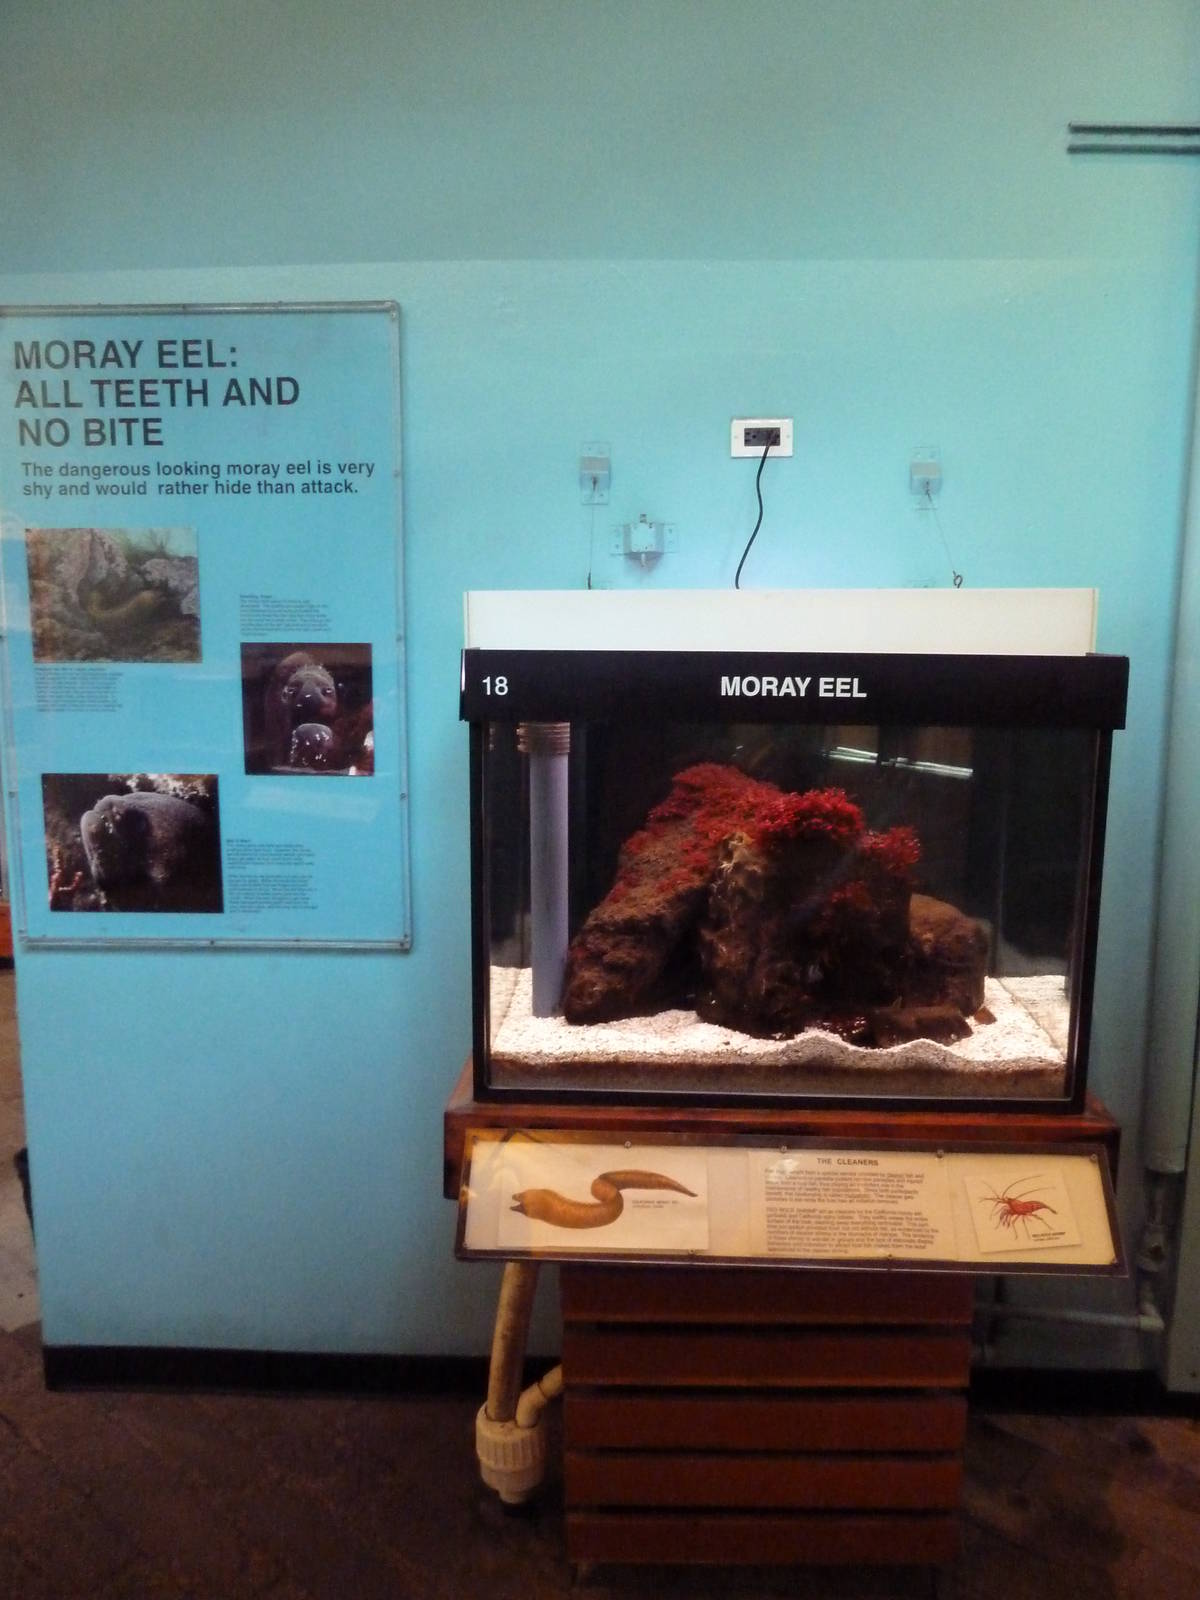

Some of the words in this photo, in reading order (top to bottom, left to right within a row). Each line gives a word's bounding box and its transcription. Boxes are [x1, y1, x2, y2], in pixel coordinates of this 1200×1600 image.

[14, 339, 144, 369] MORAY
[157, 339, 238, 368] EEL:
[14, 379, 83, 409] ALL
[90, 378, 209, 408] TEETH
[222, 376, 300, 407] AND
[18, 418, 70, 447] NO
[84, 417, 164, 446] BITE
[21, 462, 53, 477] The
[59, 462, 151, 480] dangerous
[156, 461, 221, 479] looking
[226, 463, 280, 478] moray
[286, 460, 312, 475] eel
[317, 460, 332, 475] is
[337, 462, 375, 478] very
[23, 482, 52, 499] shy
[58, 482, 90, 496] and
[95, 481, 148, 496] would
[158, 480, 209, 495] rather
[215, 480, 251, 494] hide
[257, 480, 295, 494] than
[300, 479, 359, 494] attack.
[482, 676, 509, 695] 18
[720, 676, 811, 696] MORAY
[818, 677, 868, 697] EEL
[816, 1157, 833, 1165] THE
[836, 1158, 879, 1167] CLEANERS
